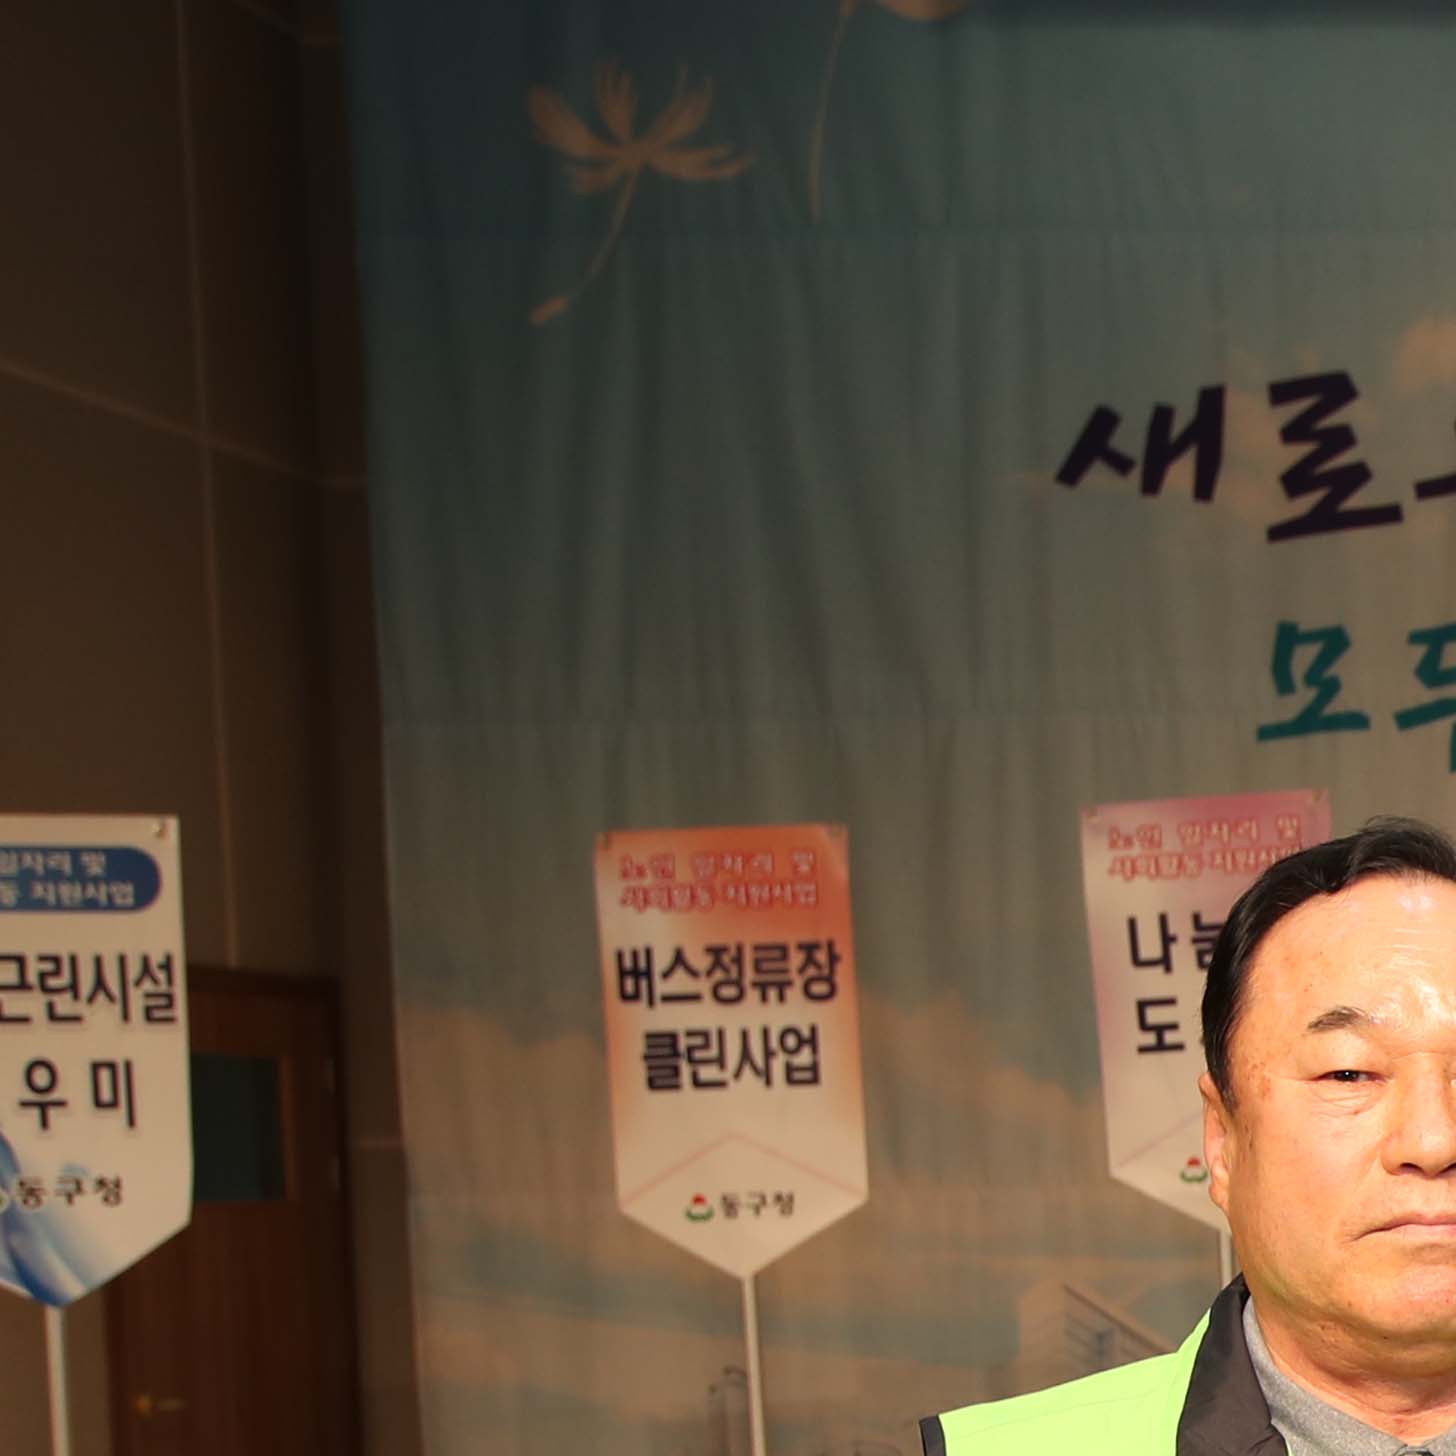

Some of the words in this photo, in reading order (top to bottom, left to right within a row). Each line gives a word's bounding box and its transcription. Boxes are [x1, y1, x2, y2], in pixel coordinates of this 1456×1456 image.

[616, 940, 842, 1009] 버스정류장
[642, 1023, 822, 1093] 클린사업
[17, 1175, 122, 1206] 동구청
[719, 1192, 795, 1220] 동구청
